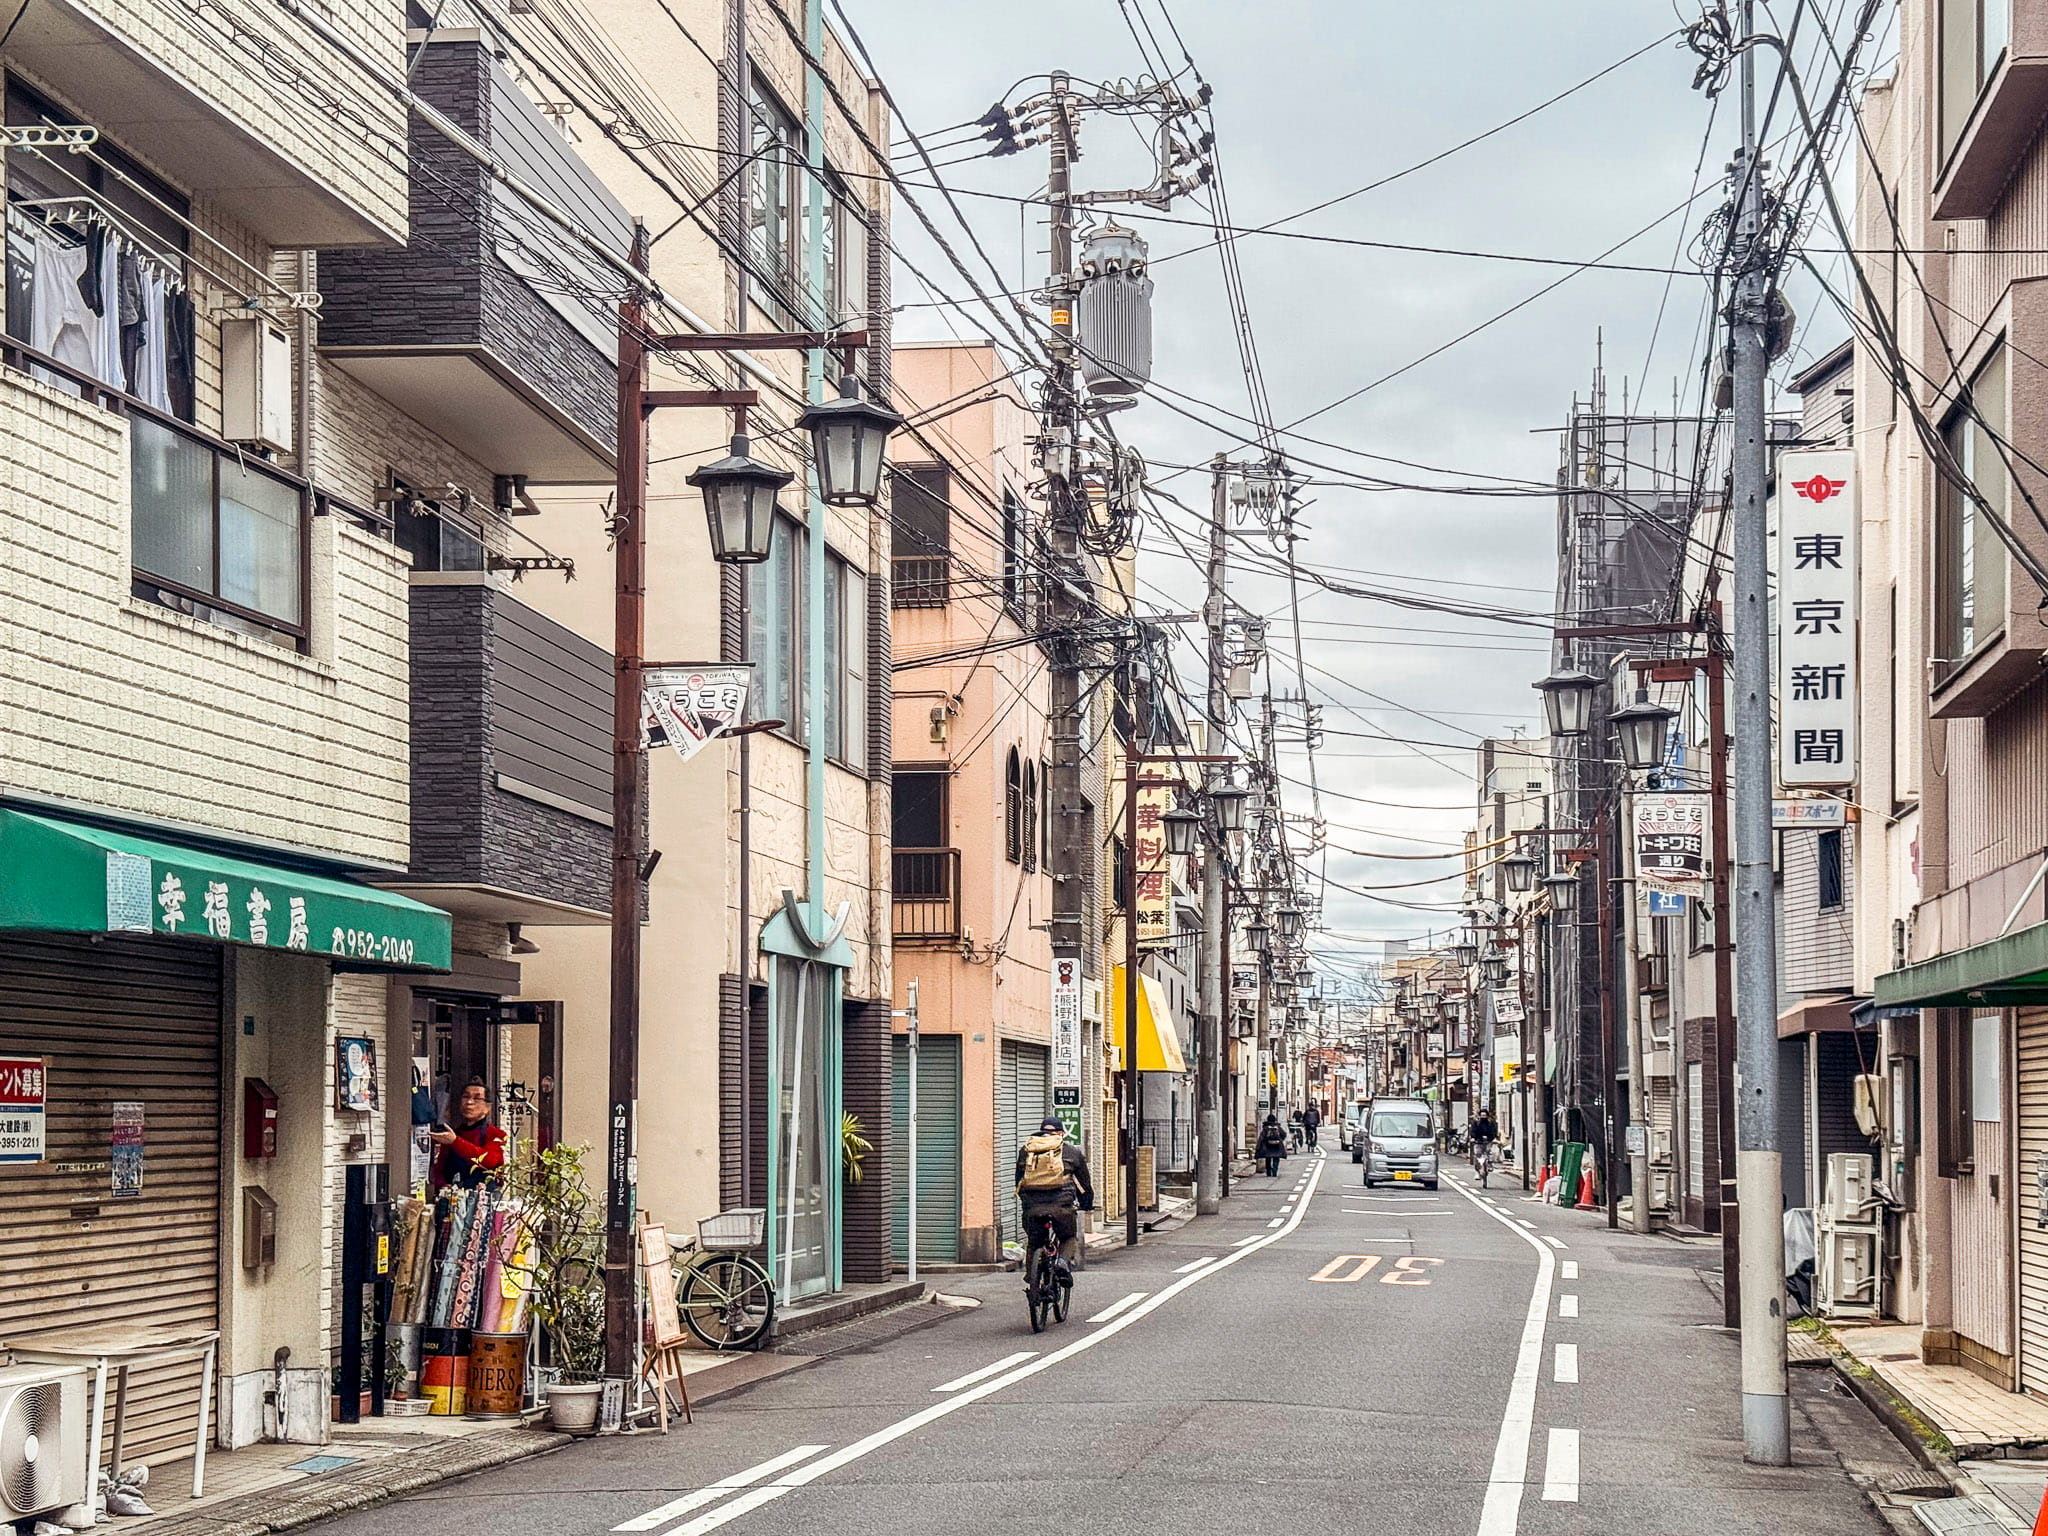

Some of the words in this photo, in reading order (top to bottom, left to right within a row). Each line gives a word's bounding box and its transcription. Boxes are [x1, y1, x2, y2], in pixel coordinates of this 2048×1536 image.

[1791, 532, 1846, 765] 東京新聞
[1639, 807, 1703, 822] ようこそ
[1137, 768, 1165, 902] 中華料理
[1640, 836, 1702, 853] トキワ荘
[1658, 855, 1685, 868] 通り
[157, 871, 310, 951] 幸福書房
[346, 927, 414, 964] 952-2049
[1061, 1118, 1078, 1140] 文
[471, 1367, 516, 1392] PIERS
